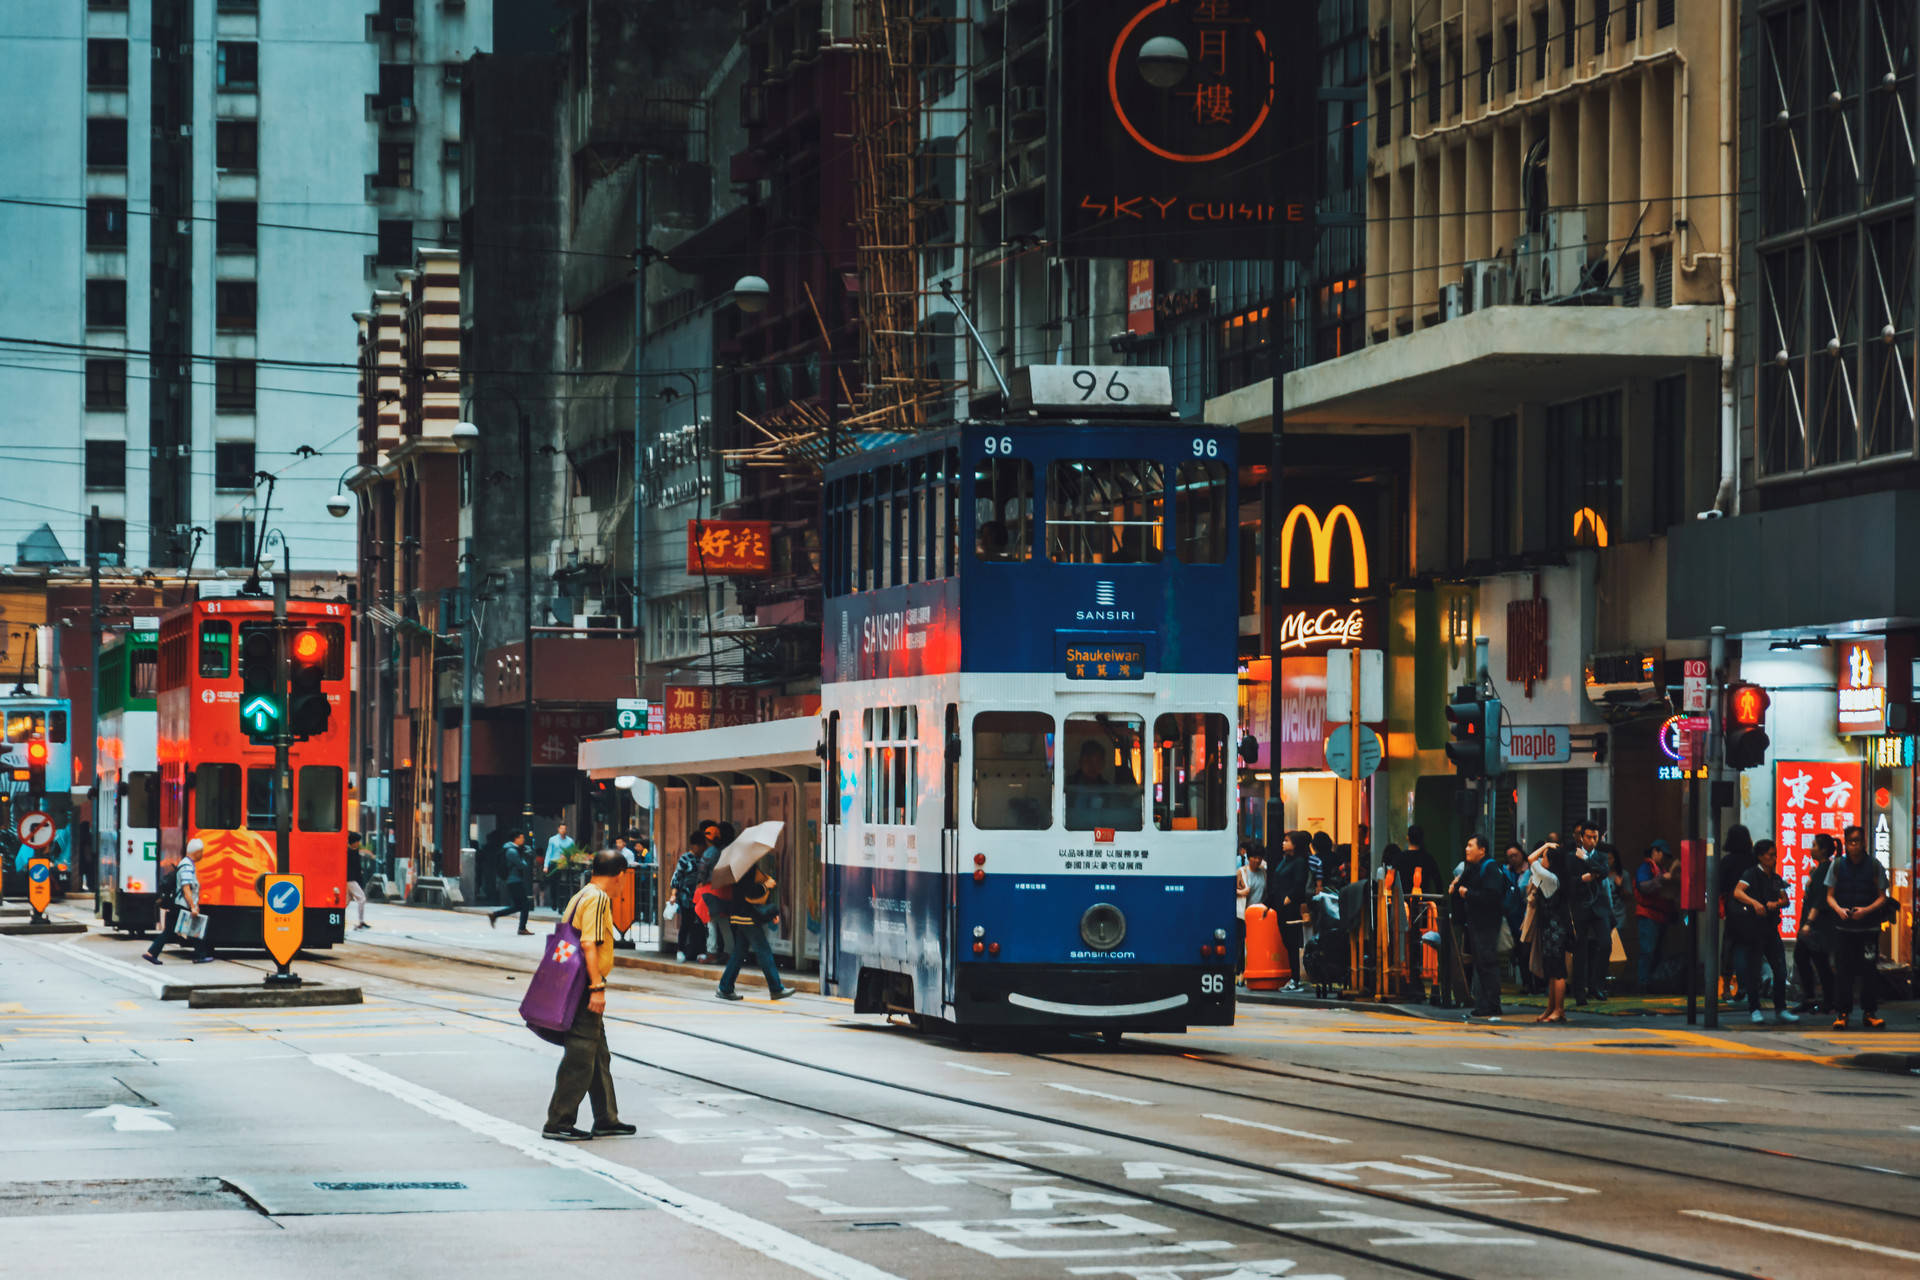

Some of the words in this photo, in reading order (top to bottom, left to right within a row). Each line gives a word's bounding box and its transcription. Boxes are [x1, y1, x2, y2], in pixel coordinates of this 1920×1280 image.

[1081, 195, 1177, 219] SKY
[1072, 370, 1129, 402] 96
[984, 436, 1012, 455] 96
[1192, 438, 1217, 457] 96
[695, 527, 766, 558] 好彩
[207, 602, 221, 613] 81
[326, 604, 340, 615] 81
[1076, 611, 1135, 620] SANSIRI
[863, 611, 904, 653] SANSIRI
[1281, 609, 1363, 648] McCafé
[1066, 648, 1139, 661] Shaukeiwan
[1281, 688, 1327, 742] wellco
[1511, 728, 1556, 760] maple
[1782, 770, 1853, 809] 東方
[329, 913, 340, 925] 81
[1070, 951, 1135, 959] sansiri.com
[1202, 974, 1223, 993] 96
